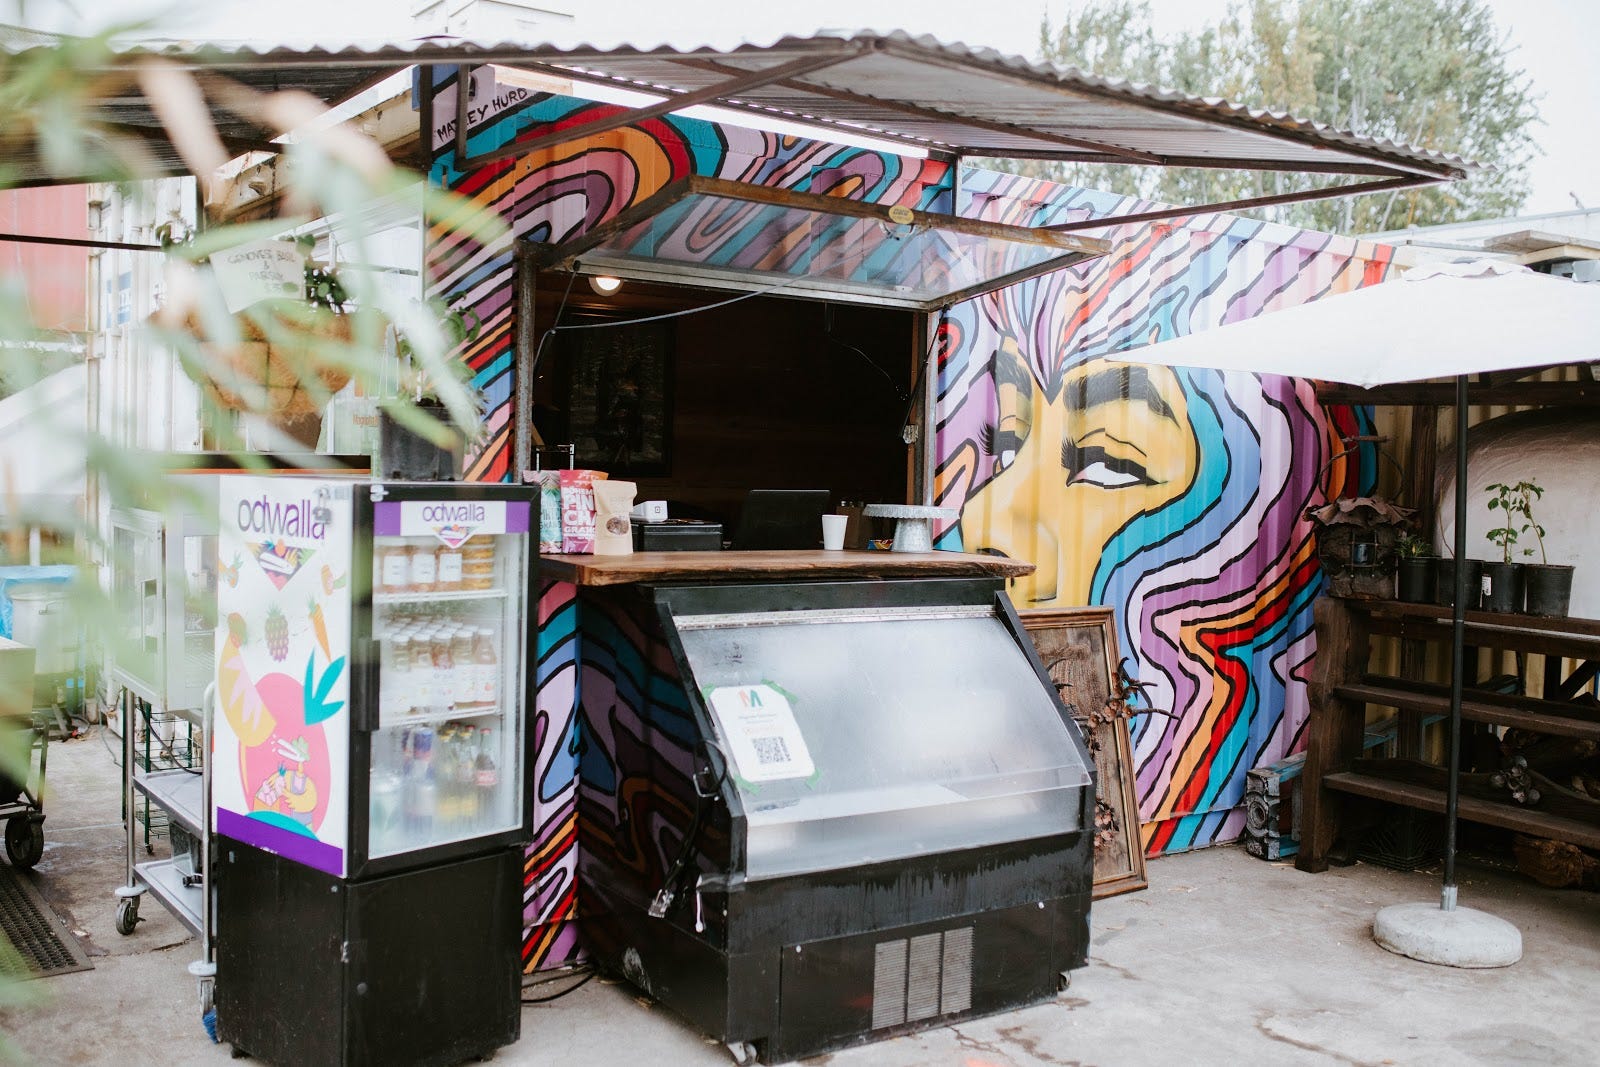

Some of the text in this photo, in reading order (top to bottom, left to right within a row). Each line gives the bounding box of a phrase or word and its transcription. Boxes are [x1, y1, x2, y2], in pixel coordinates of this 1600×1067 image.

[437, 87, 528, 142] MATEY HURD
[237, 495, 326, 539] odwalla
[422, 503, 486, 523] odwalla
